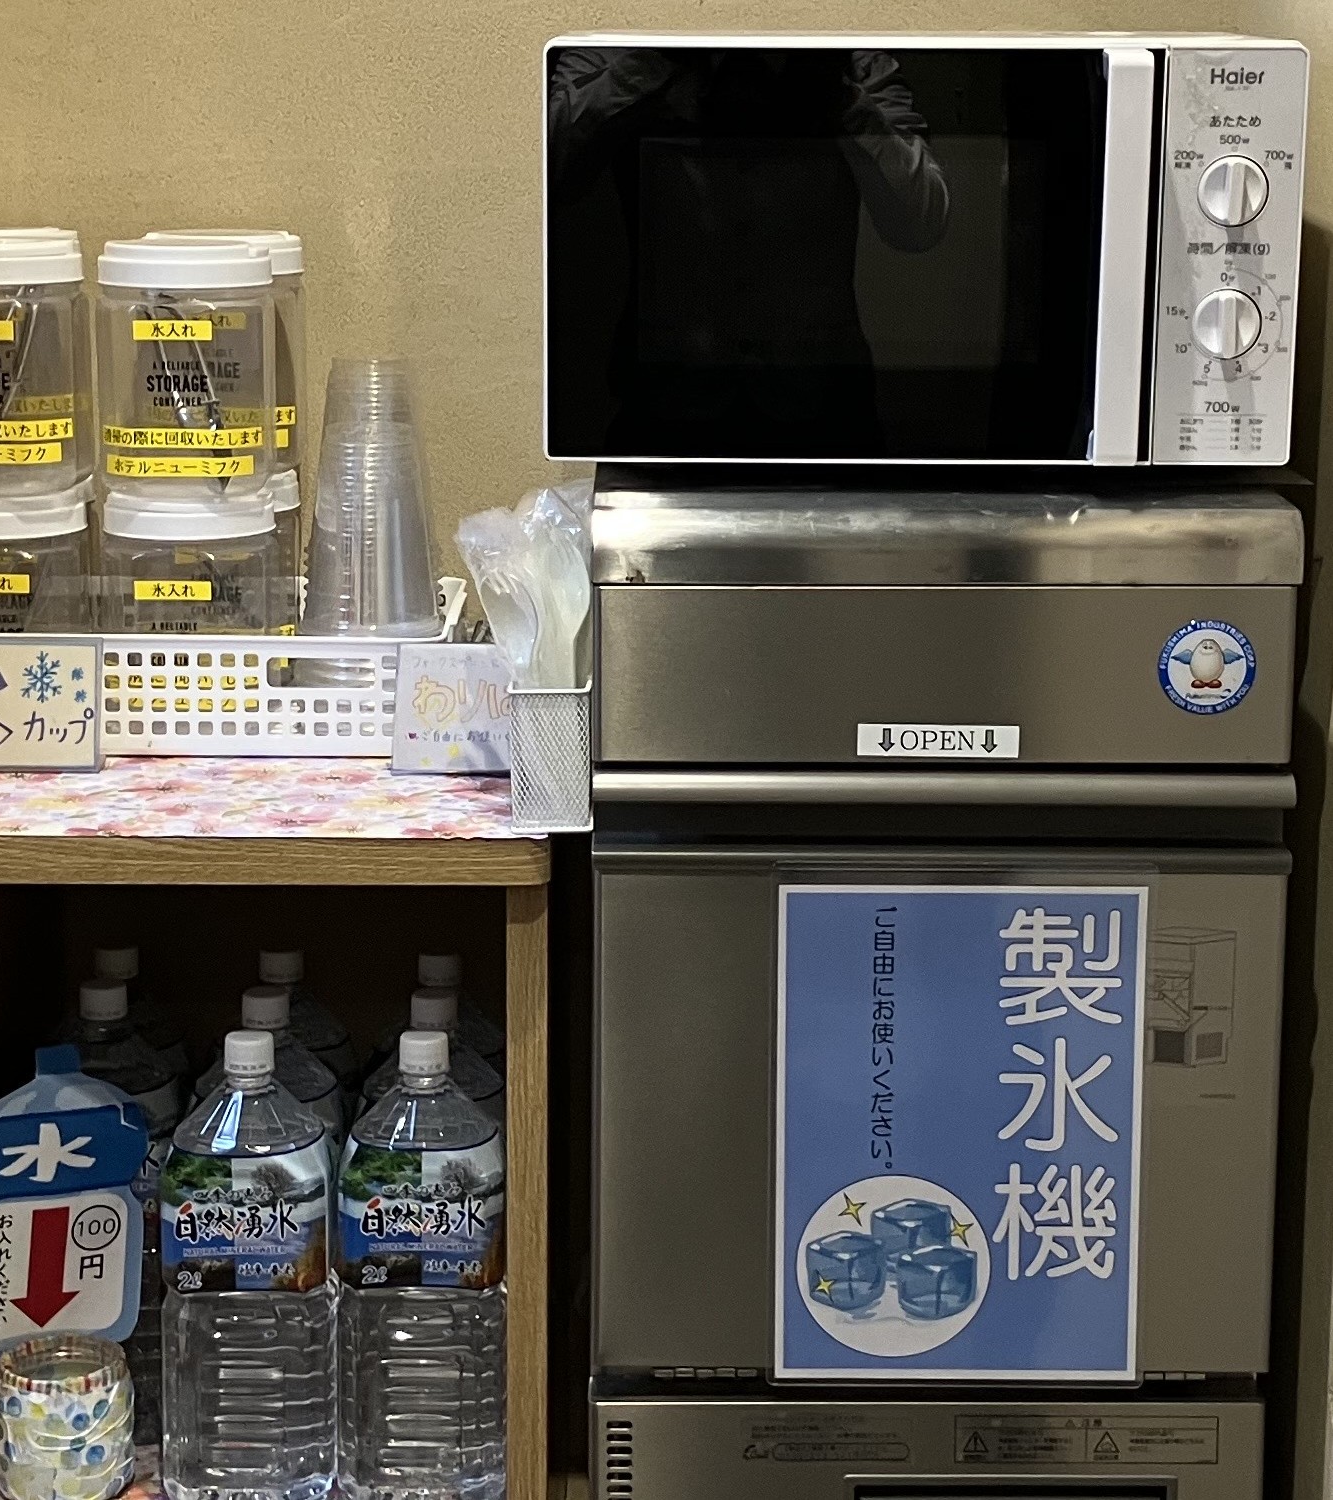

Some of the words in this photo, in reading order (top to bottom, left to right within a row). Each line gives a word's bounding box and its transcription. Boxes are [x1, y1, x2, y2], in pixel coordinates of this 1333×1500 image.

[1211, 67, 1264, 84] Haier
[1210, 115, 1261, 127] あたため
[1235, 363, 1242, 373] 4
[146, 374, 208, 393] STORAGE
[153, 396, 202, 407] CONTAINER
[114, 459, 241, 475] ホテルニューミフク
[1159, 625, 1194, 670] FUKUSHIMA
[1187, 704, 1213, 713] VALUE
[1215, 698, 1237, 711] WITH
[23, 707, 94, 745] カップ
[900, 730, 975, 752] OPEN
[869, 905, 898, 1170] ご自由にお使いください。
[991, 906, 1123, 1281] 製氷機
[77, 1217, 116, 1238] 100
[174, 1198, 300, 1244] 自然湧水
[360, 1194, 486, 1240] 自然湧水
[79, 1253, 104, 1280] 円
